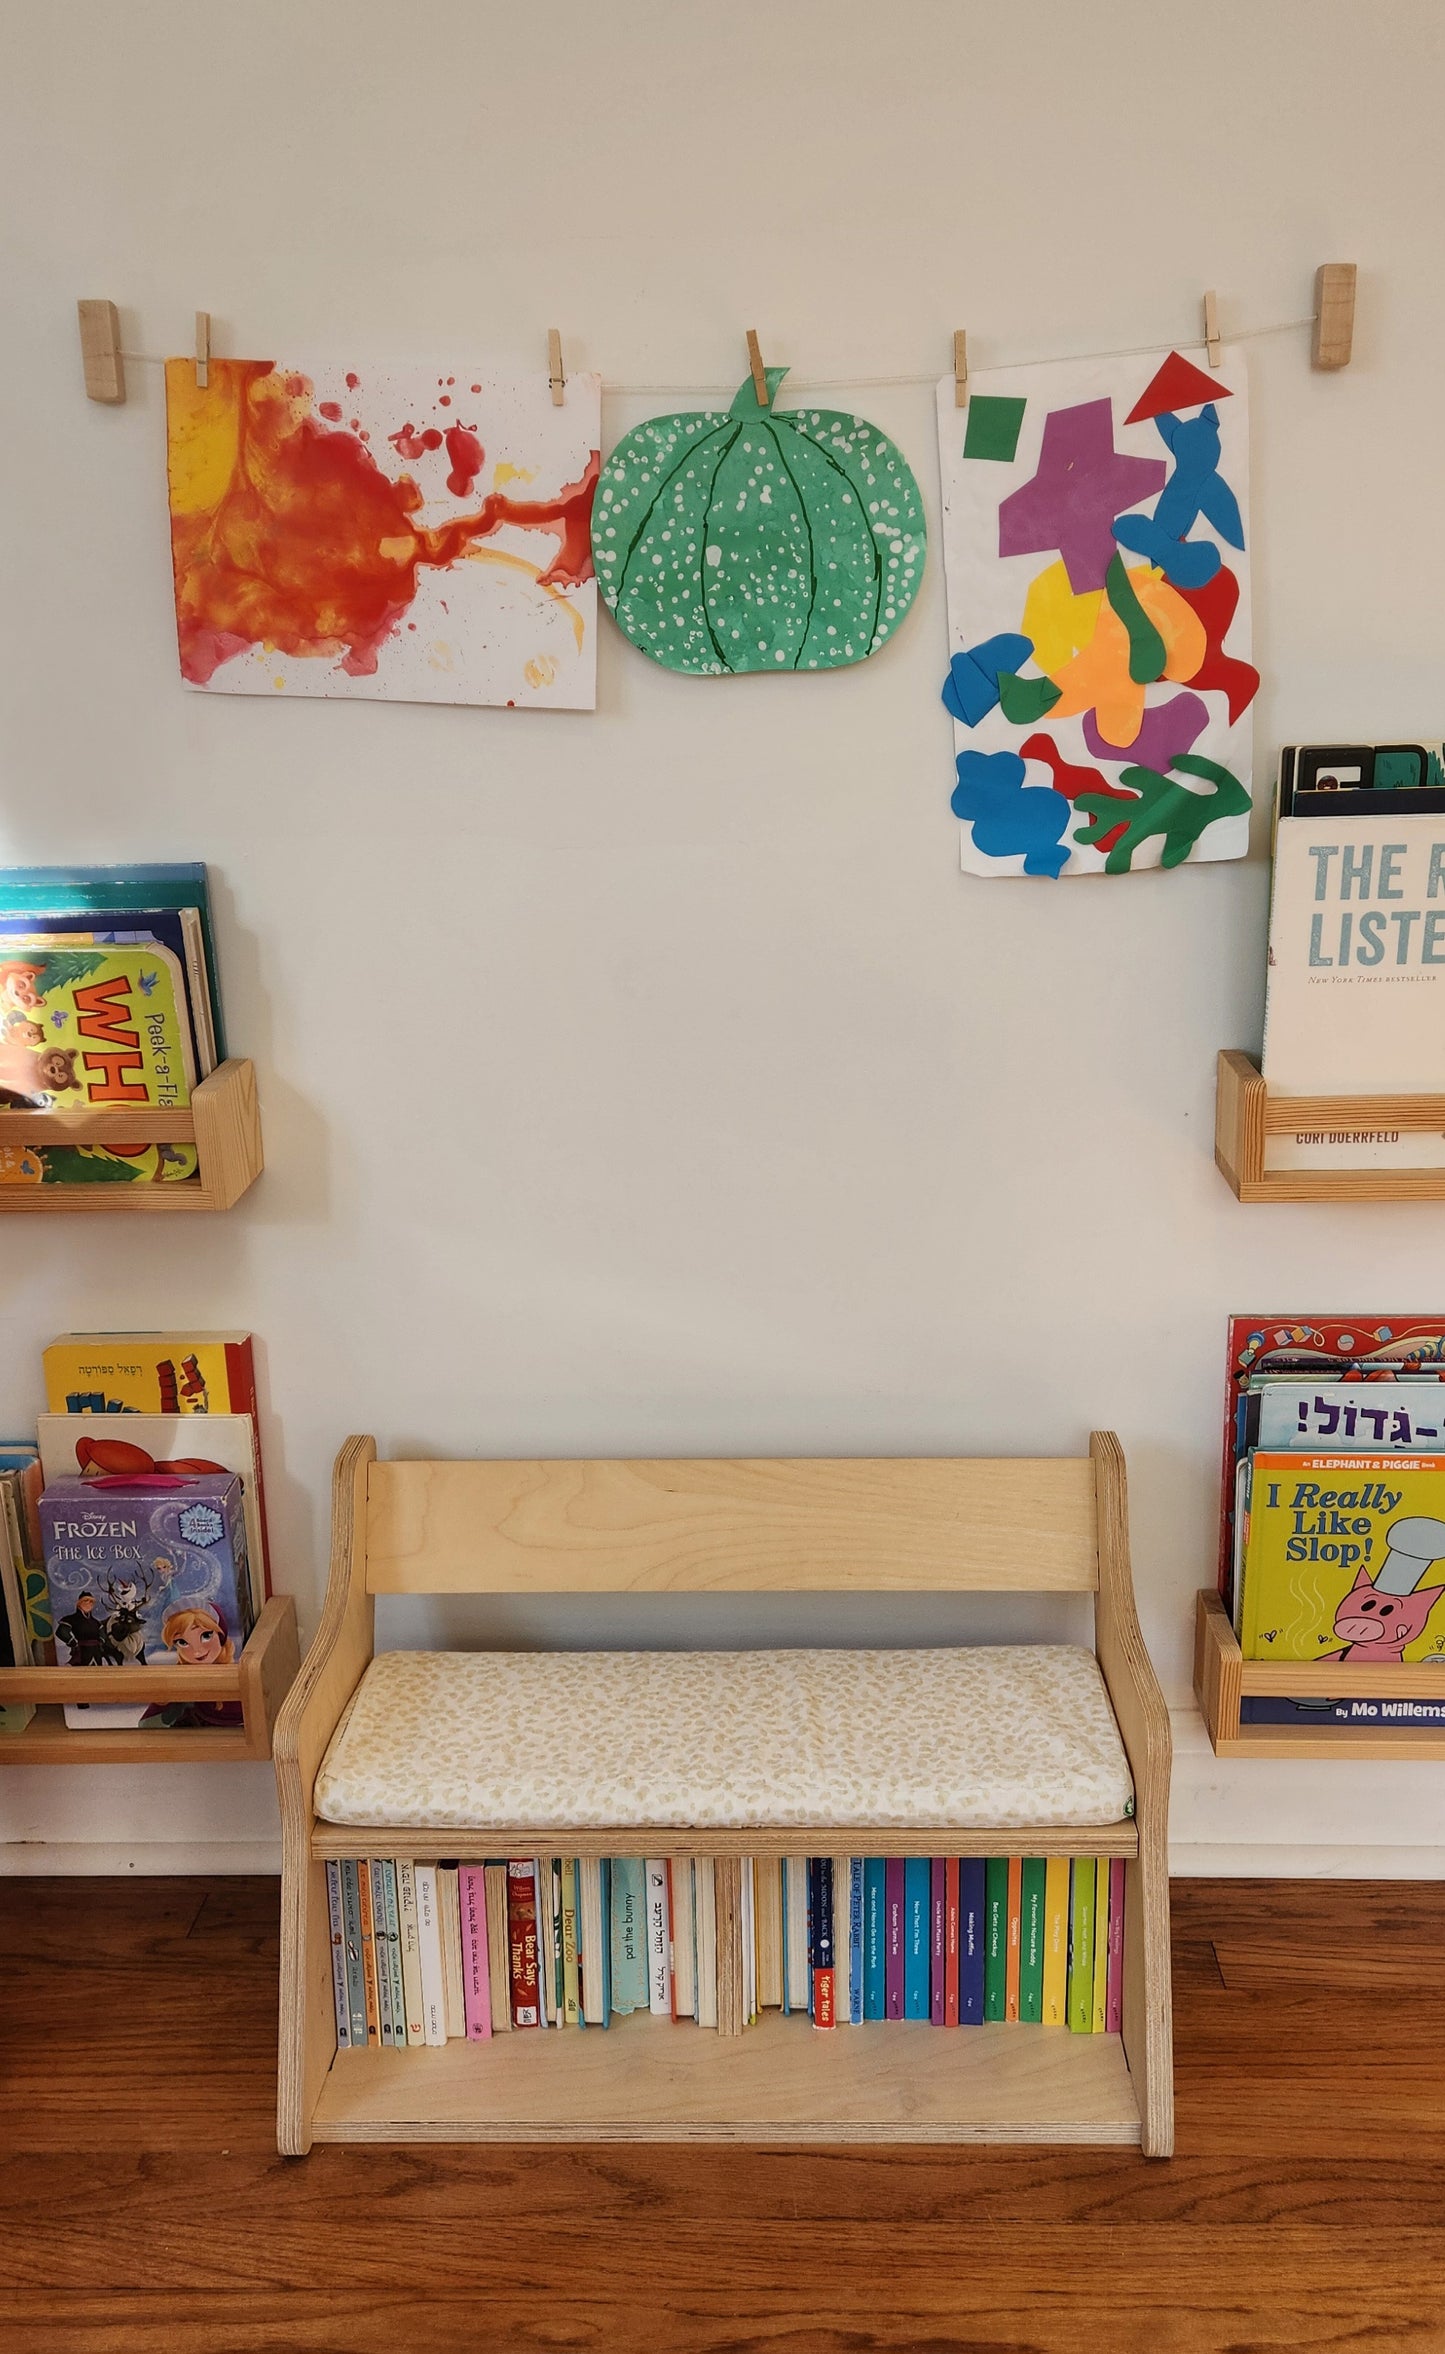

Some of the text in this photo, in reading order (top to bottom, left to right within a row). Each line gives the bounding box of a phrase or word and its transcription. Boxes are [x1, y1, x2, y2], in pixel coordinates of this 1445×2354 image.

[1308, 843, 1408, 901] THE
[1308, 911, 1445, 967] LISTE
[1312, 1459, 1372, 1470] ELEPHANT
[1373, 1460, 1381, 1469] &
[1383, 1459, 1420, 1470] PIGGIE
[1266, 1482, 1403, 1513] I Really
[53, 1520, 137, 1540] FROZEN
[1292, 1510, 1372, 1535] Like
[52, 1543, 142, 1561] THE ICE BOX
[1286, 1536, 1374, 1568] Slop!
[1335, 1708, 1348, 1718] By
[1351, 1702, 1378, 1716] Mo
[853, 1861, 861, 1881] TALE
[820, 1884, 829, 1908] MOON
[853, 1894, 861, 1920] PETER
[564, 1909, 576, 1963] Dear Zoo
[622, 1893, 636, 1960] pat the bunny
[853, 1921, 861, 1949] RABBIT
[991, 1932, 999, 1957] Checkup
[512, 1942, 524, 1980] Thanks
[525, 1934, 538, 1987] Bear Says
[820, 1976, 831, 1998] tiger
[820, 1999, 831, 2021] tales
[853, 1988, 861, 2014] WARNE
